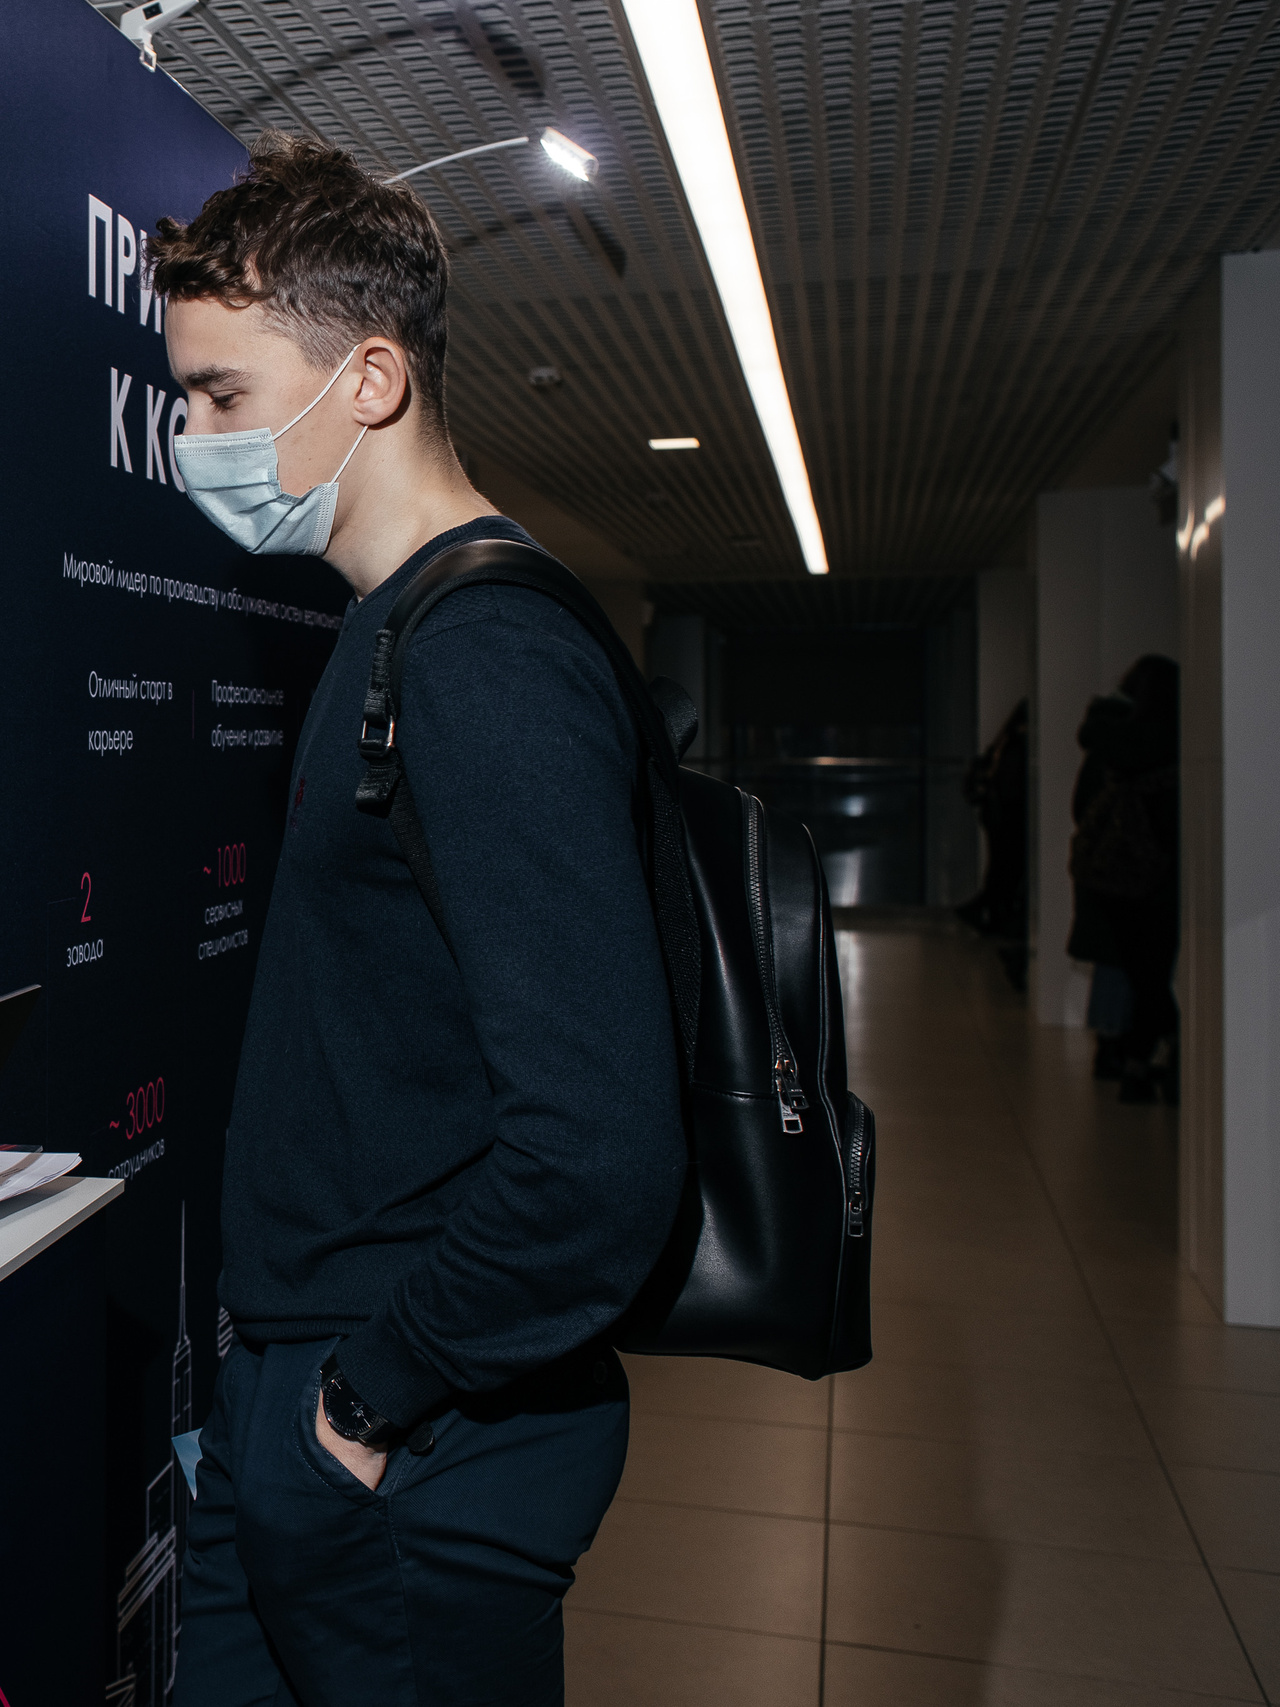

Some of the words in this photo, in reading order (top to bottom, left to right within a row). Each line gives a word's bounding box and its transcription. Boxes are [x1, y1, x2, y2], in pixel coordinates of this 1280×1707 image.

[88, 193, 168, 334] ПРИ
[110, 366, 133, 474] К
[63, 551, 114, 588] Мировой
[116, 569, 148, 598] лидер
[149, 575, 162, 595] по
[163, 578, 220, 611] производству
[88, 670, 138, 699] Отличный
[140, 679, 166, 706] старт
[168, 682, 173, 701] в
[211, 679, 284, 708] Профессиональное
[88, 729, 134, 757] карьере
[211, 723, 247, 752] обучение
[254, 729, 284, 751] развитие
[80, 871, 92, 923] 2
[204, 899, 244, 927] сервисных
[66, 938, 104, 968] завода
[198, 929, 249, 961] специалистов
